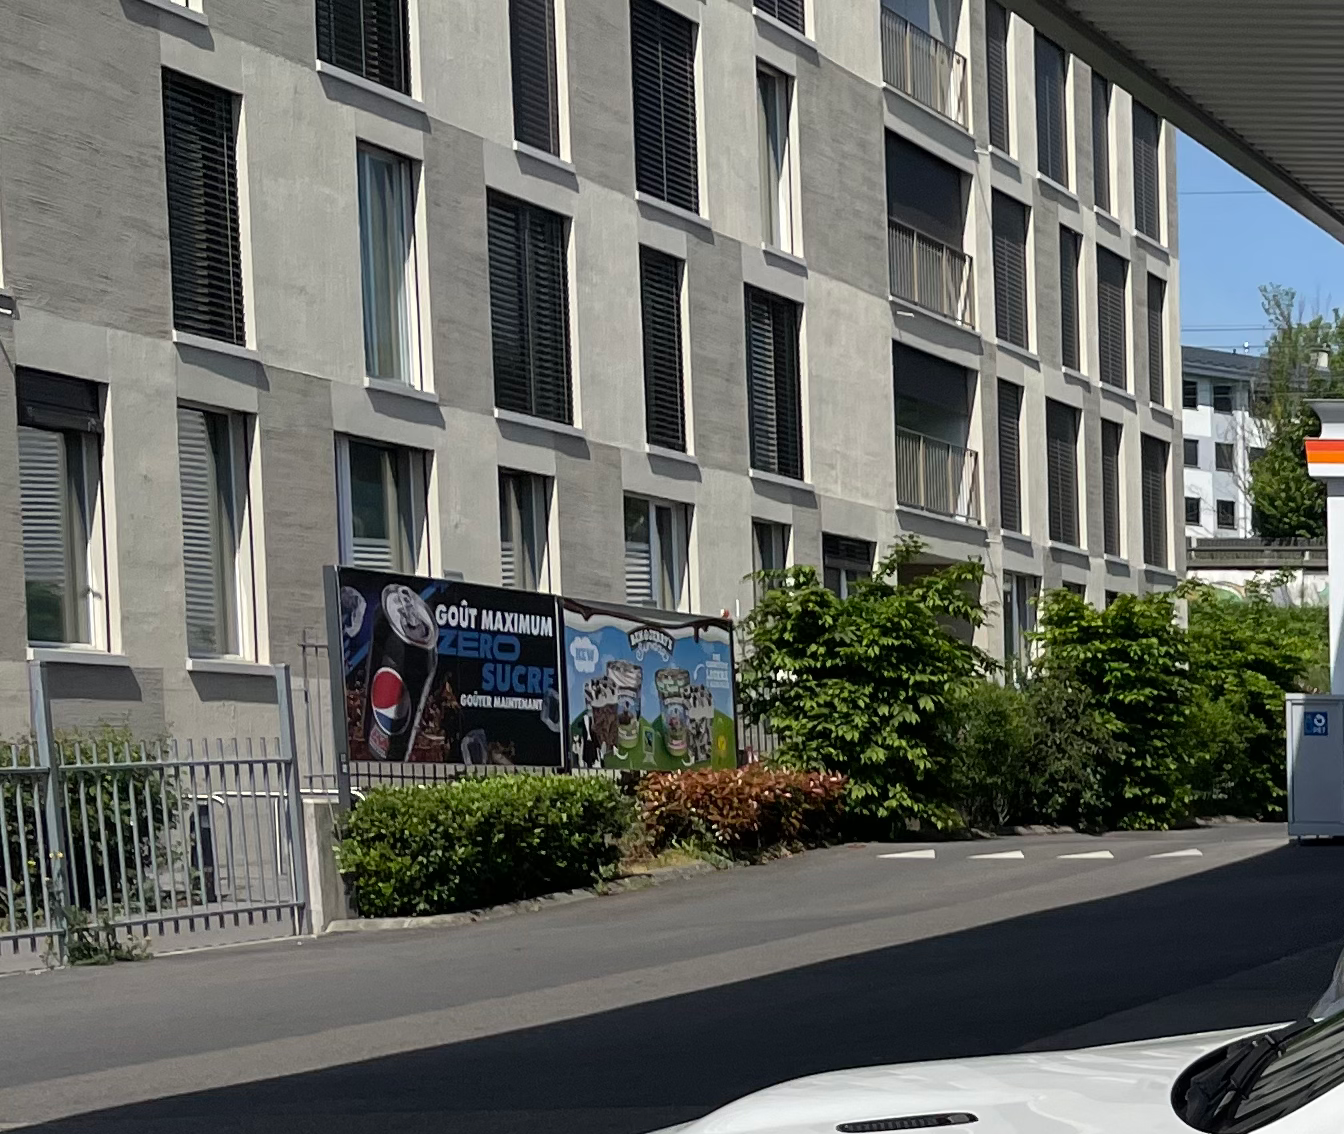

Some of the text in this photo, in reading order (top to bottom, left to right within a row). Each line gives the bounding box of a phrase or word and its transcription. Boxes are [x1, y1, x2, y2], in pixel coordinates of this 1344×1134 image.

[435, 599, 553, 637] GOÛT MAXIMUM
[438, 628, 521, 661] ZERO
[481, 662, 555, 694] SUCRE
[460, 690, 543, 711] GOÛTER MAINTENANT
